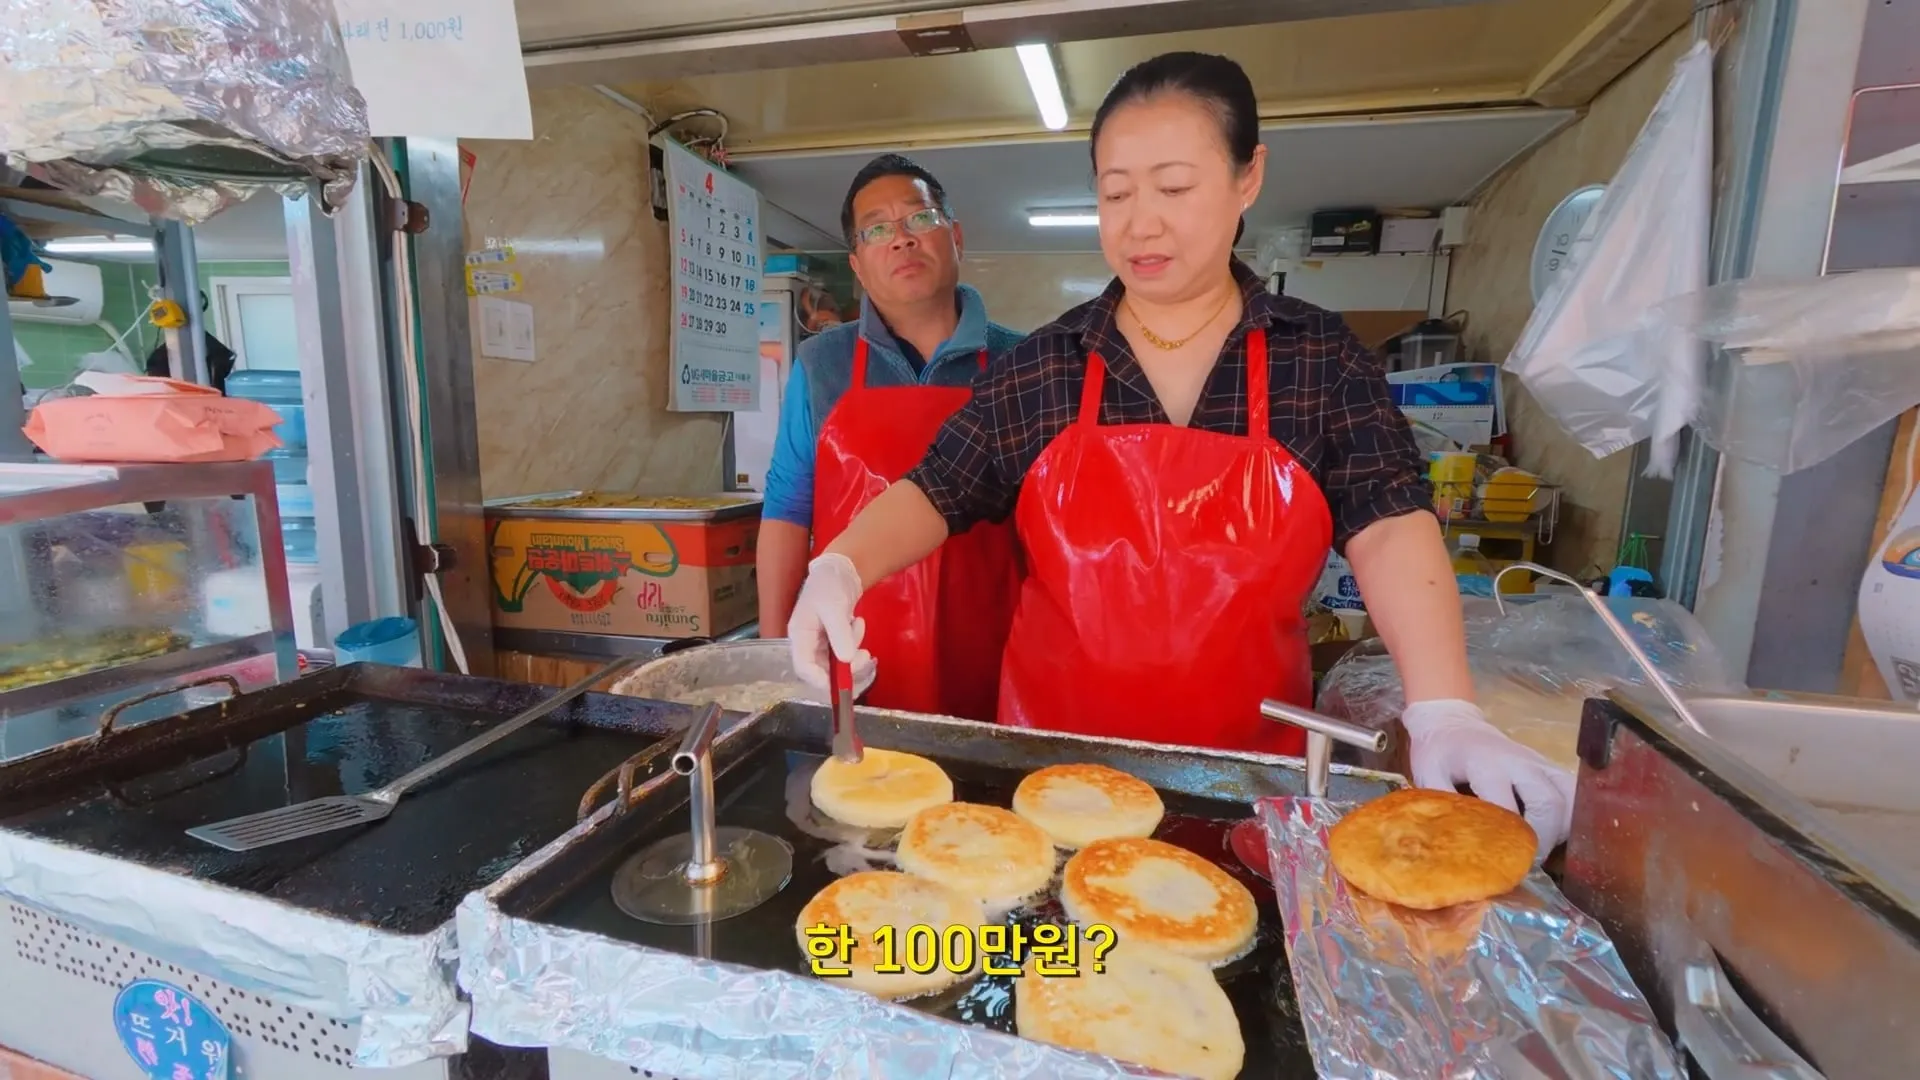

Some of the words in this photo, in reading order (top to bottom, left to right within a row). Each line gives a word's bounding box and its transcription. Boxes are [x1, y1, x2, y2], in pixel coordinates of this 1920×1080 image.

[400, 15, 464, 41] 1,000원
[705, 172, 714, 195] 4
[707, 217, 712, 229] 1
[719, 222, 726, 235] 2
[733, 226, 741, 239] 3
[747, 230, 753, 243] 4
[681, 229, 686, 243] 5
[689, 233, 694, 248] 6
[705, 242, 712, 256] 8
[719, 247, 725, 260] 9
[731, 250, 741, 264] 10
[746, 254, 756, 268] 11
[680, 257, 688, 273] 12
[688, 260, 695, 276] 13
[704, 268, 713, 283] 15
[716, 272, 727, 286] 16
[730, 275, 741, 289] 17
[744, 279, 755, 292] 18
[680, 285, 688, 301] 19
[688, 288, 696, 301] 20
[704, 293, 713, 307] 22
[715, 296, 727, 310] 23
[730, 299, 741, 313] 24
[744, 302, 755, 316] 25
[680, 314, 688, 329] 26
[688, 315, 695, 329] 27
[704, 319, 713, 332] 29
[715, 321, 727, 335] 30
[531, 534, 587, 551] Mountain
[646, 611, 700, 632] Sumifru
